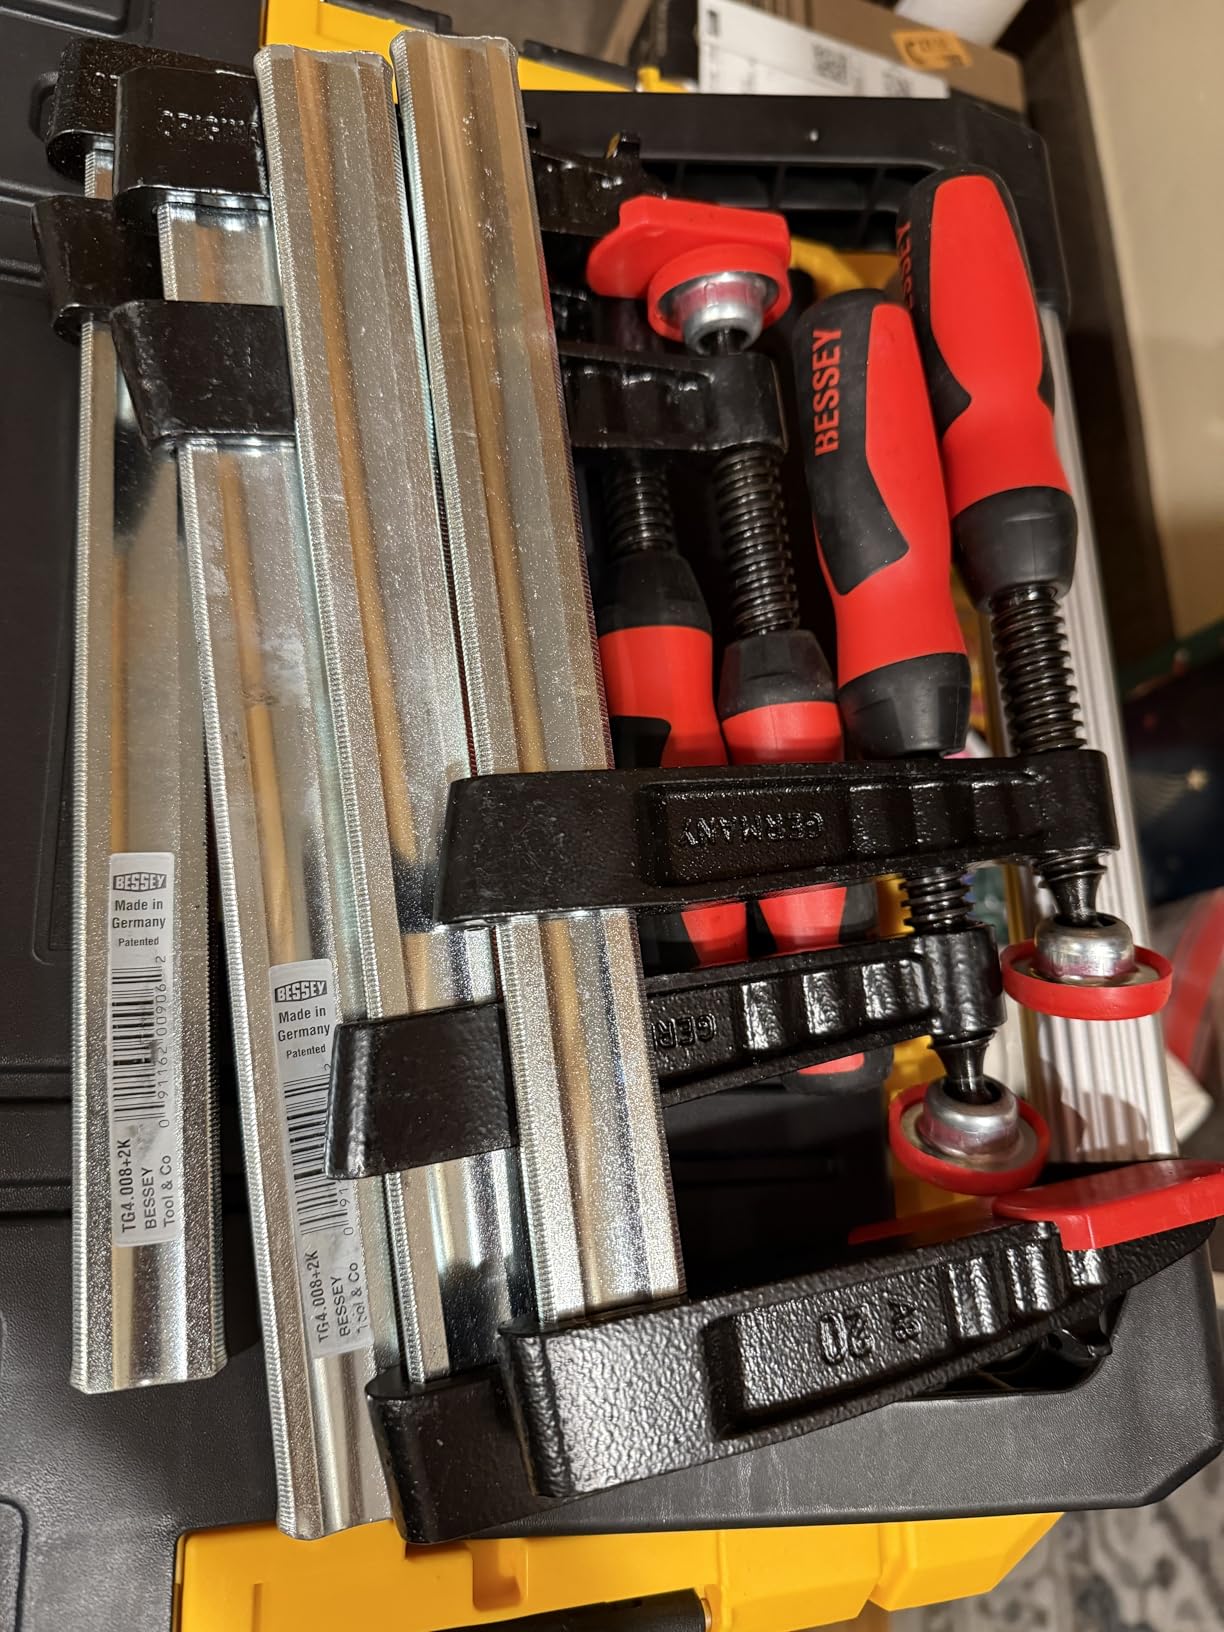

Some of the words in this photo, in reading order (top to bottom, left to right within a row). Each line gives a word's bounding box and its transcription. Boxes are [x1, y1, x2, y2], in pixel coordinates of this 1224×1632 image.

[812, 328, 842, 456] BESSEY
[681, 812, 824, 846] GERMANY
[114, 872, 167, 892] BESSEY
[115, 899, 148, 911] Made
[152, 898, 163, 910] in
[112, 917, 166, 929] Germany
[118, 937, 159, 947] Patented
[155, 955, 166, 963] 2
[275, 980, 327, 1002] BESSEY
[155, 983, 167, 1037] 00906
[279, 1008, 311, 1023] Made
[315, 1006, 326, 1017] in
[277, 1024, 331, 1042] Germany
[652, 1012, 717, 1049] GER
[286, 1044, 326, 1060] Patented
[159, 1119, 170, 1128] 0
[160, 1155, 172, 1175] Co
[117, 1138, 136, 1233] TG4.008+2K
[161, 1180, 173, 1190] &
[141, 1167, 157, 1230] BESSEY
[161, 1195, 175, 1227] Tool
[348, 1262, 360, 1282] Co
[305, 1250, 328, 1344] TG4.008+2K
[351, 1286, 362, 1297] &
[330, 1276, 350, 1337] BESSEY
